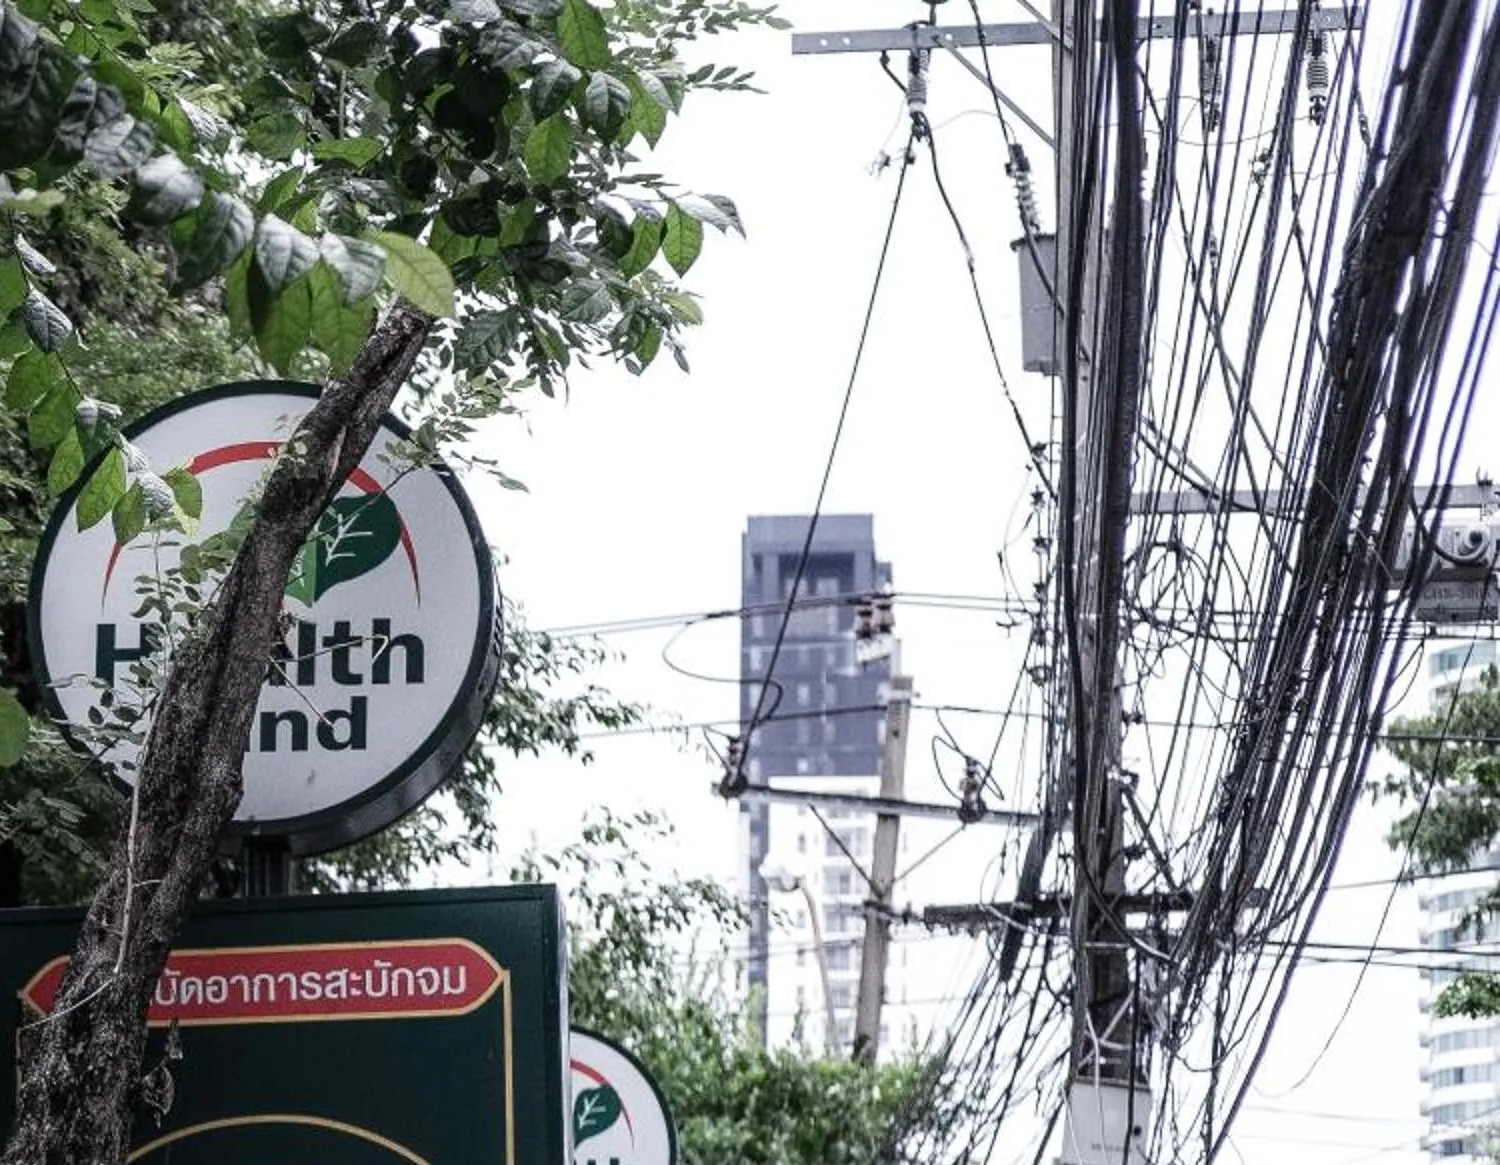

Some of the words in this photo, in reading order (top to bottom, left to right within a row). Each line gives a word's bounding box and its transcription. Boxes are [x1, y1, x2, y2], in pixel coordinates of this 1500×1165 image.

[95, 617, 426, 690] Hlth
[150, 960, 467, 1007] บัดอาการสะบักจม
